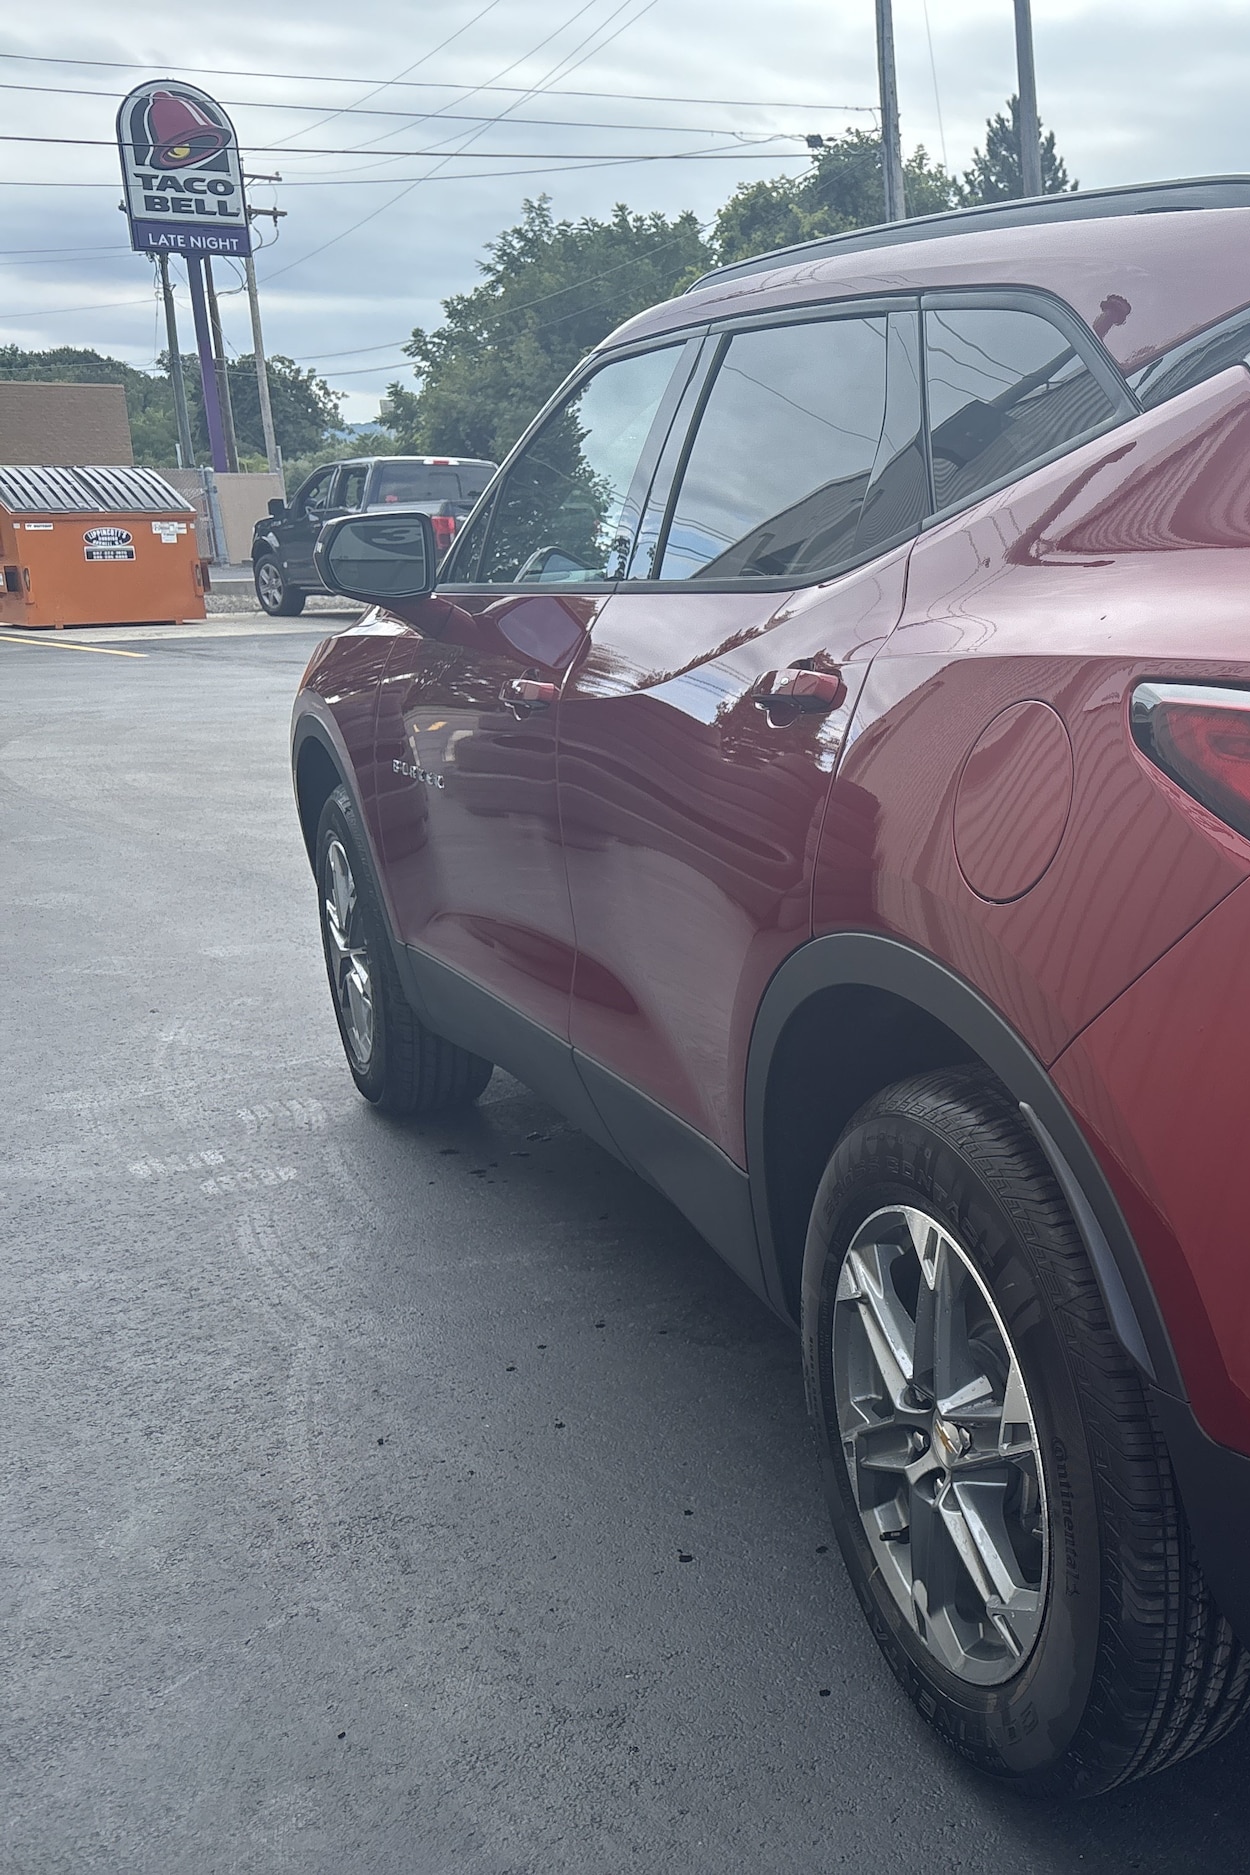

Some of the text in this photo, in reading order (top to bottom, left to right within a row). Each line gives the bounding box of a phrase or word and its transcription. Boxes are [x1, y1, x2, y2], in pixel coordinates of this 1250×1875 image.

[134, 174, 235, 195] TACO
[143, 196, 241, 217] BELL
[148, 233, 239, 250] LATE NIGHT
[1052, 1434, 1080, 1580] Continental
